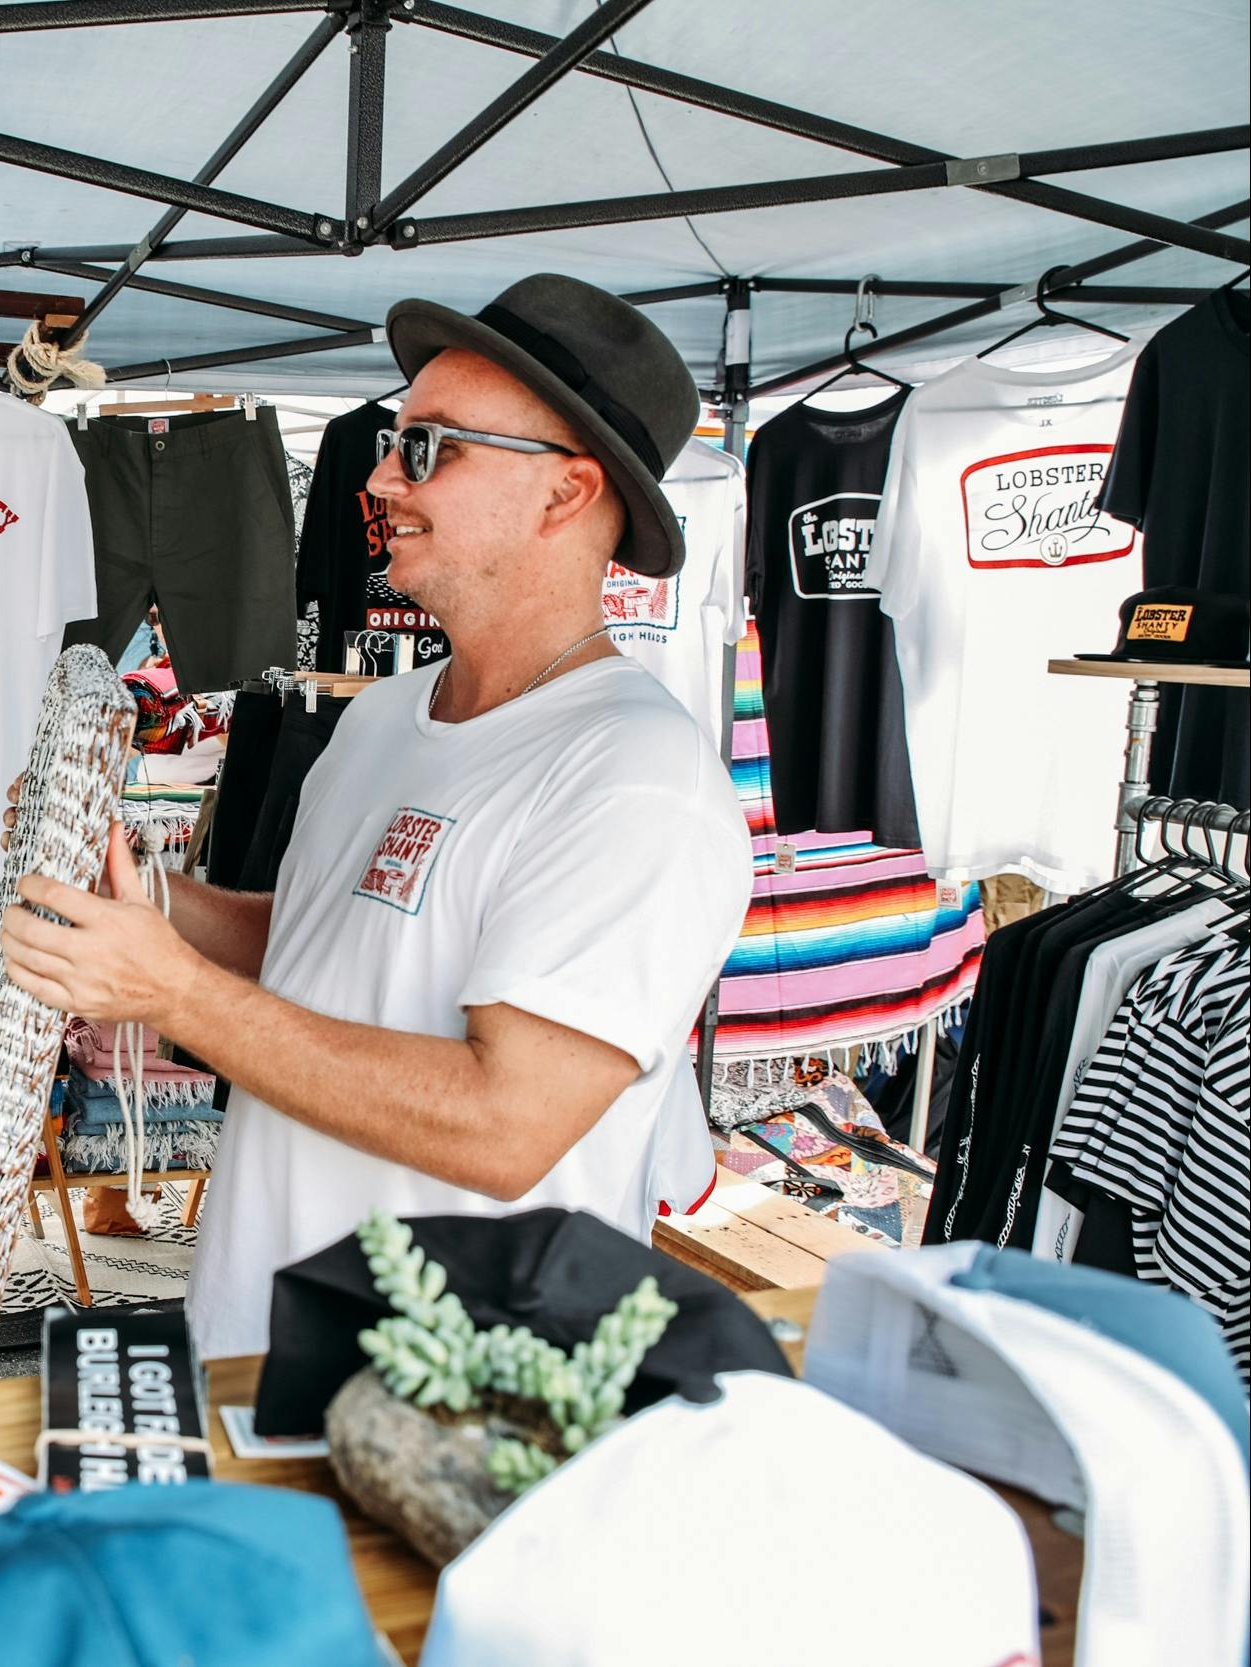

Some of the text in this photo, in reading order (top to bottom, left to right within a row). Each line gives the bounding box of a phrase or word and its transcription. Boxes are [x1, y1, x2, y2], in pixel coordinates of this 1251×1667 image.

[997, 463, 1106, 491] LOBSTER
[802, 512, 818, 524] the
[981, 490, 1101, 551] Shanty
[369, 612, 441, 627] ORIGIN
[1134, 609, 1187, 622] LOBSTER
[1136, 622, 1178, 630] SHANTY
[127, 1344, 187, 1485] I GOT FDE
